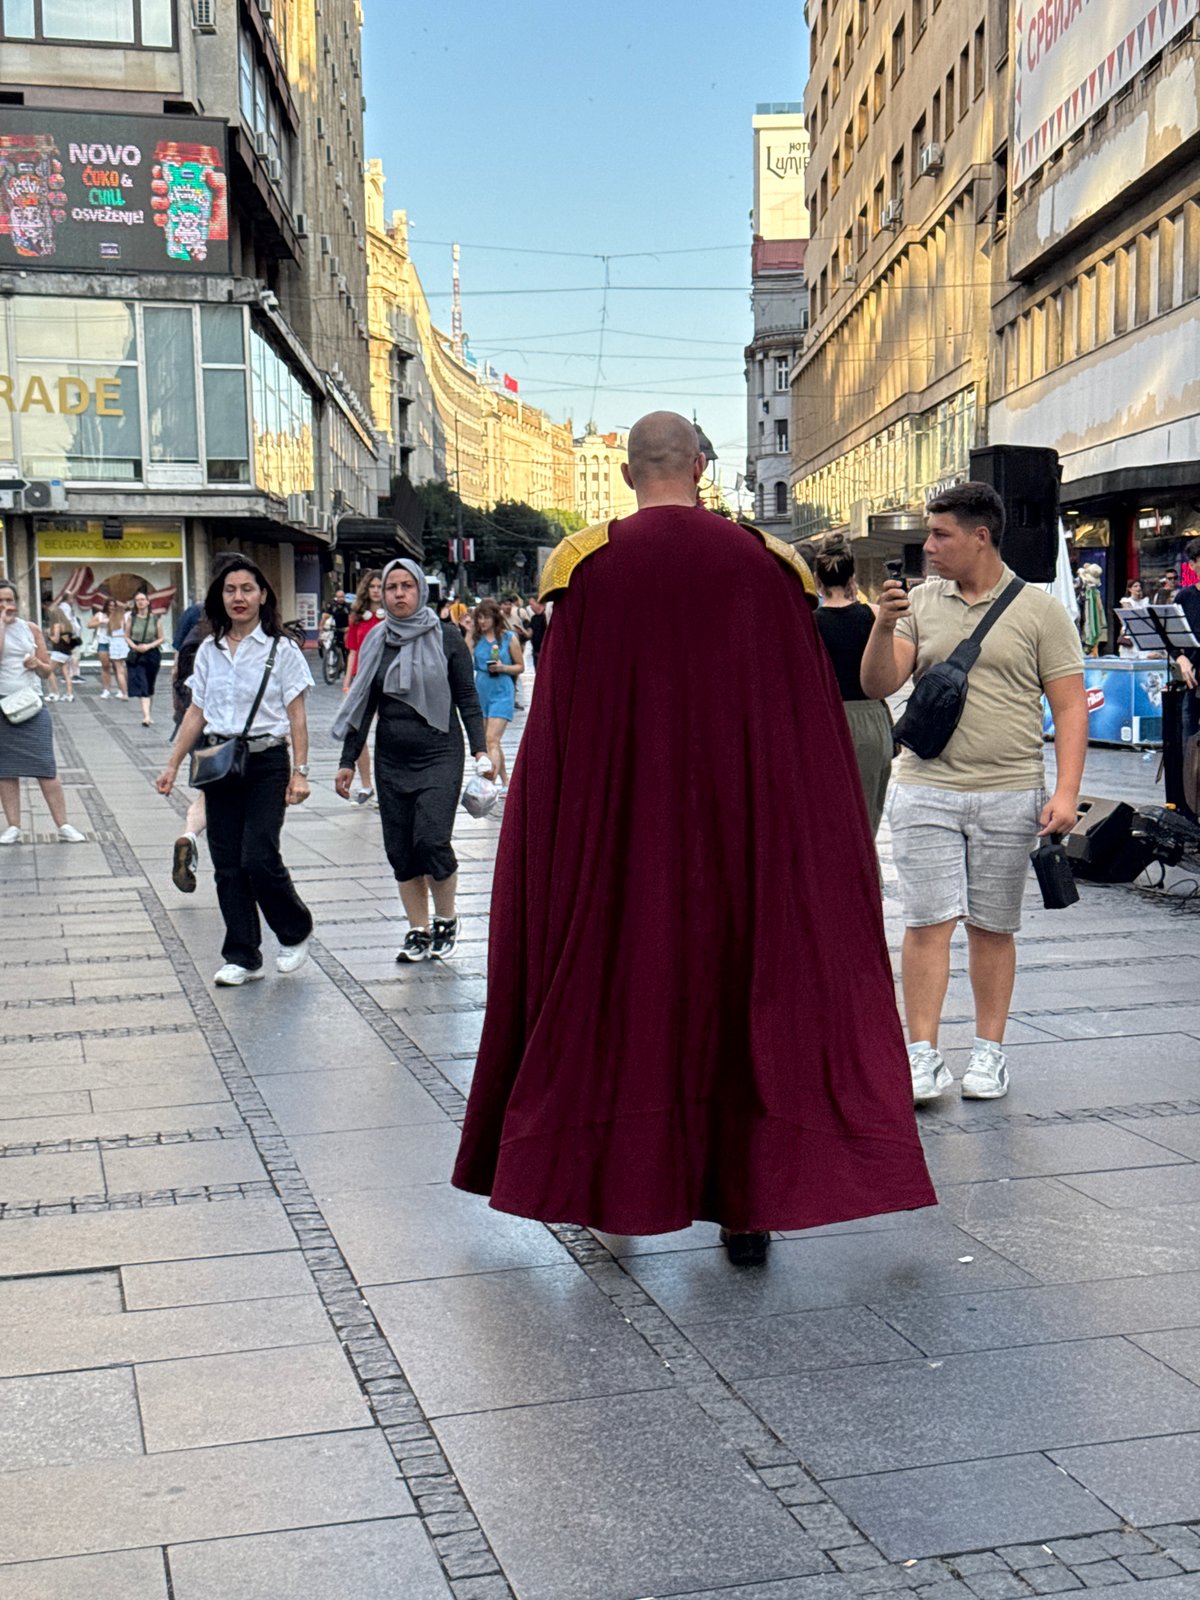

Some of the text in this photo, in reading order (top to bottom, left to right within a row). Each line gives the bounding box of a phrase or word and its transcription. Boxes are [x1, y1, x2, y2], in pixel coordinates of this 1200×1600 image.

[69, 143, 142, 166] NOVO
[121, 173, 134, 187] &
[88, 187, 126, 206] CHILL
[71, 206, 145, 226] OSVEŽENJE!
[44, 539, 101, 550] BELGRADE
[104, 539, 150, 550] WINDOW
